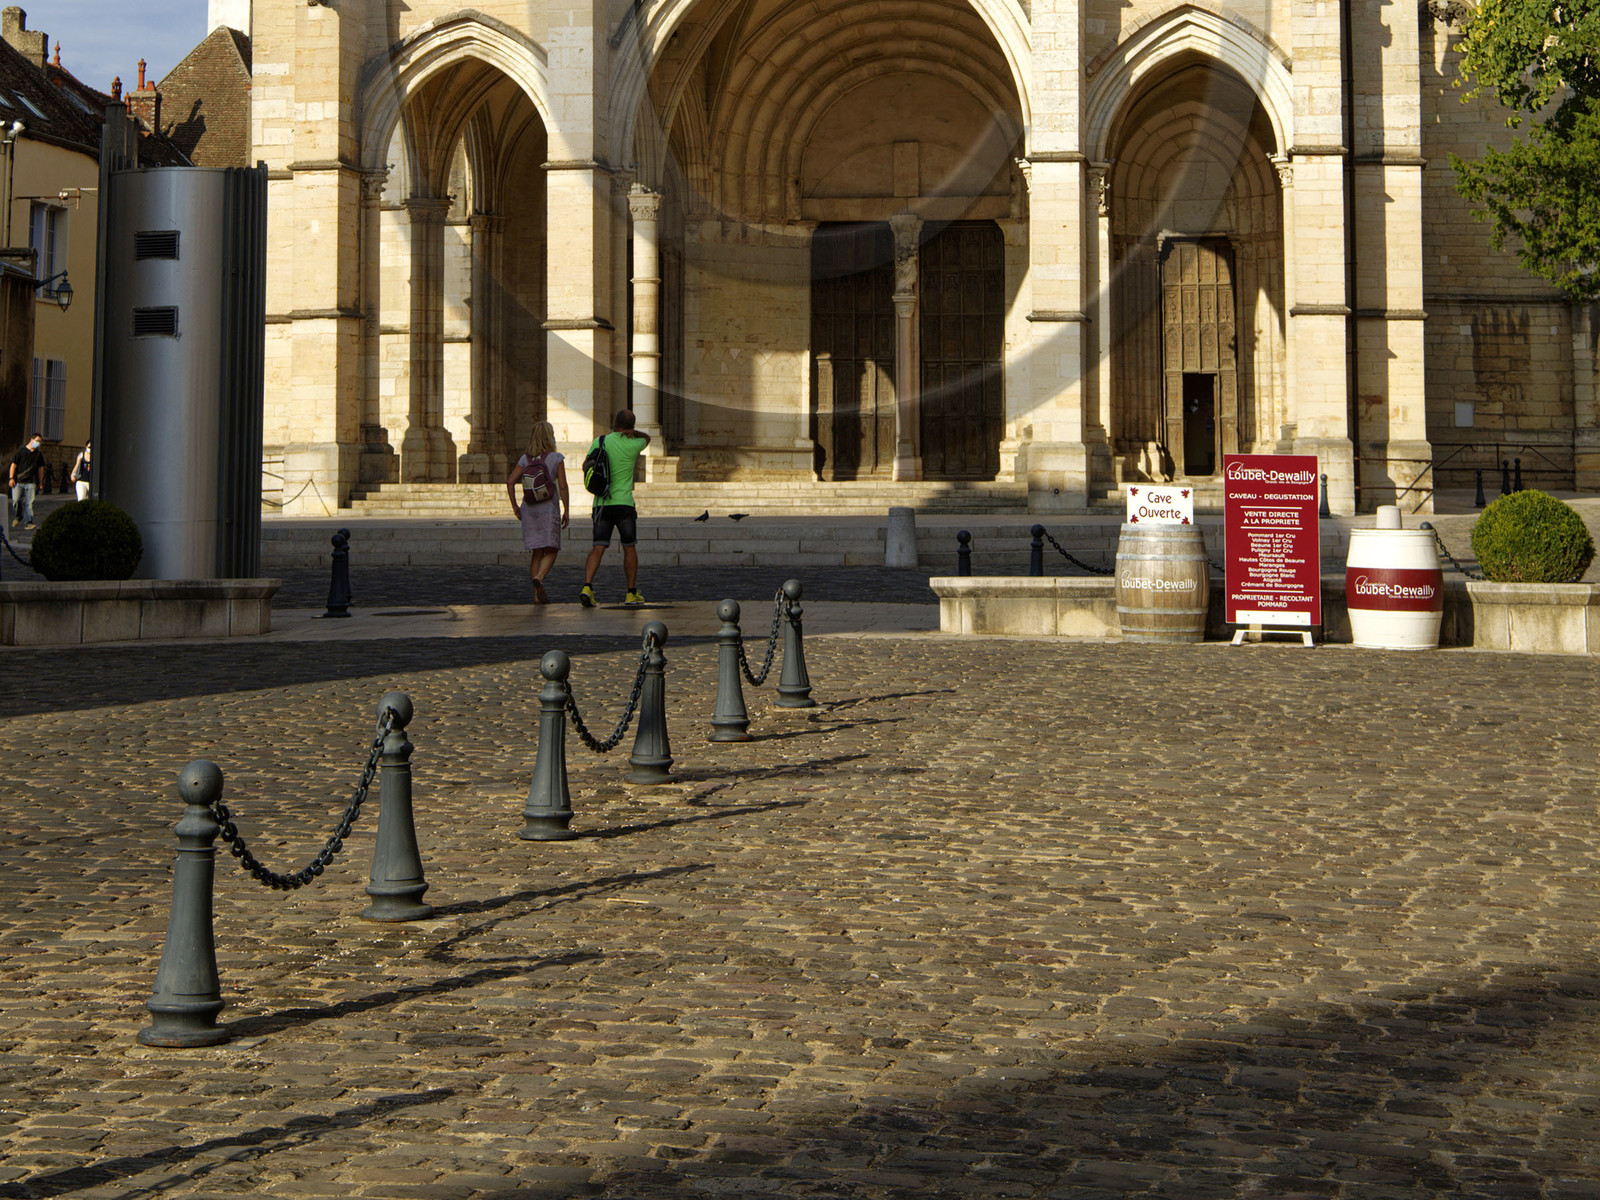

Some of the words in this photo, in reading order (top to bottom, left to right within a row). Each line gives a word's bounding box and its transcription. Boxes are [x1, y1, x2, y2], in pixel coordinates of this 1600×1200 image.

[1229, 470, 1316, 483] Loubet-Dewailly
[1147, 492, 1172, 504] Cave
[1139, 506, 1181, 519] Ouverte
[1122, 578, 1197, 591] Loubet-Dewailly
[1356, 583, 1435, 597] Loubet-Dewailly
